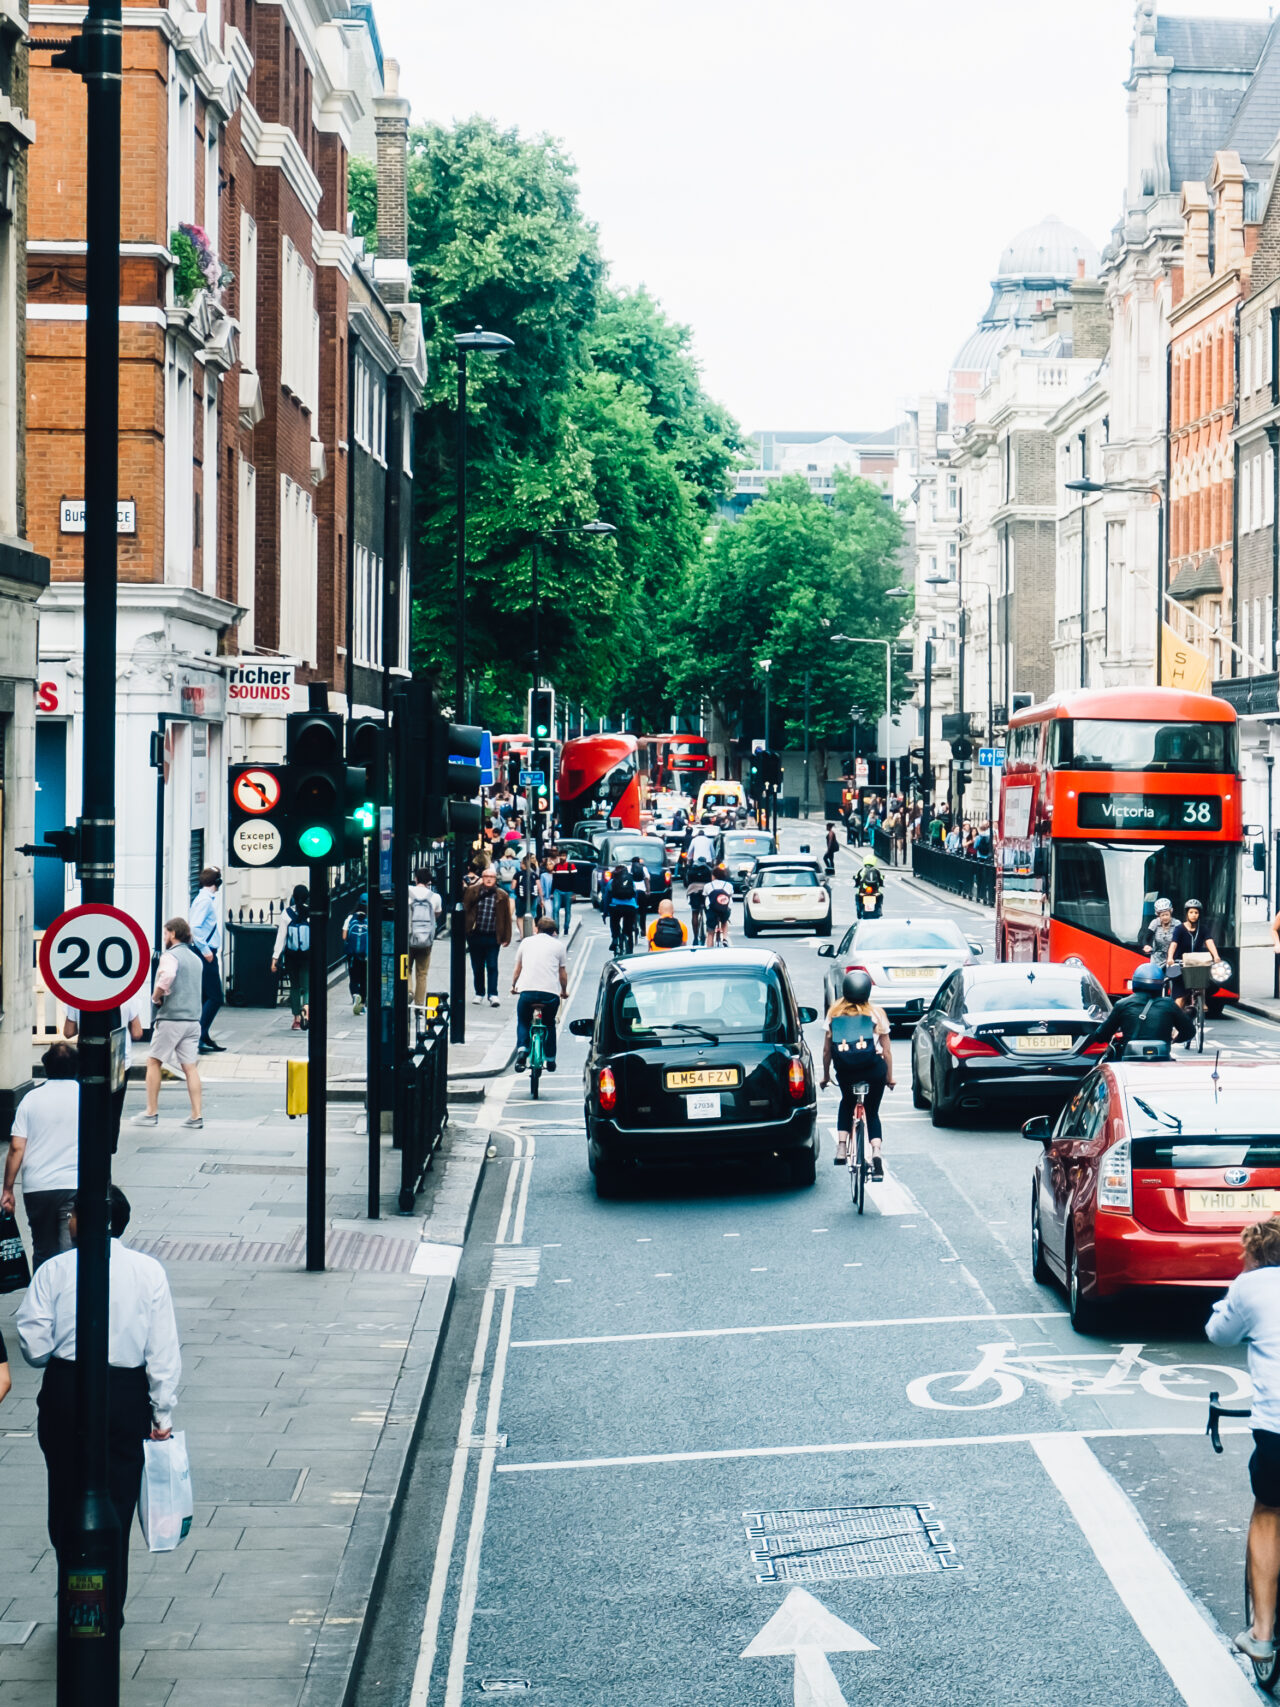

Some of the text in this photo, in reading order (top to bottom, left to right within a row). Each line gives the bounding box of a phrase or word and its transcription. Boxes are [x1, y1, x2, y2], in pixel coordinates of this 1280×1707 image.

[229, 664, 291, 685] richer
[229, 685, 291, 700] SOUNDS
[1101, 801, 1211, 823] Victoria 38
[239, 832, 275, 843] Except
[241, 842, 274, 851] cycles
[57, 936, 133, 979] 20
[1018, 1037, 1070, 1047] LT65 DPU
[672, 1071, 731, 1085] LM54 FZV
[1200, 1193, 1271, 1209] YH10 JNL
